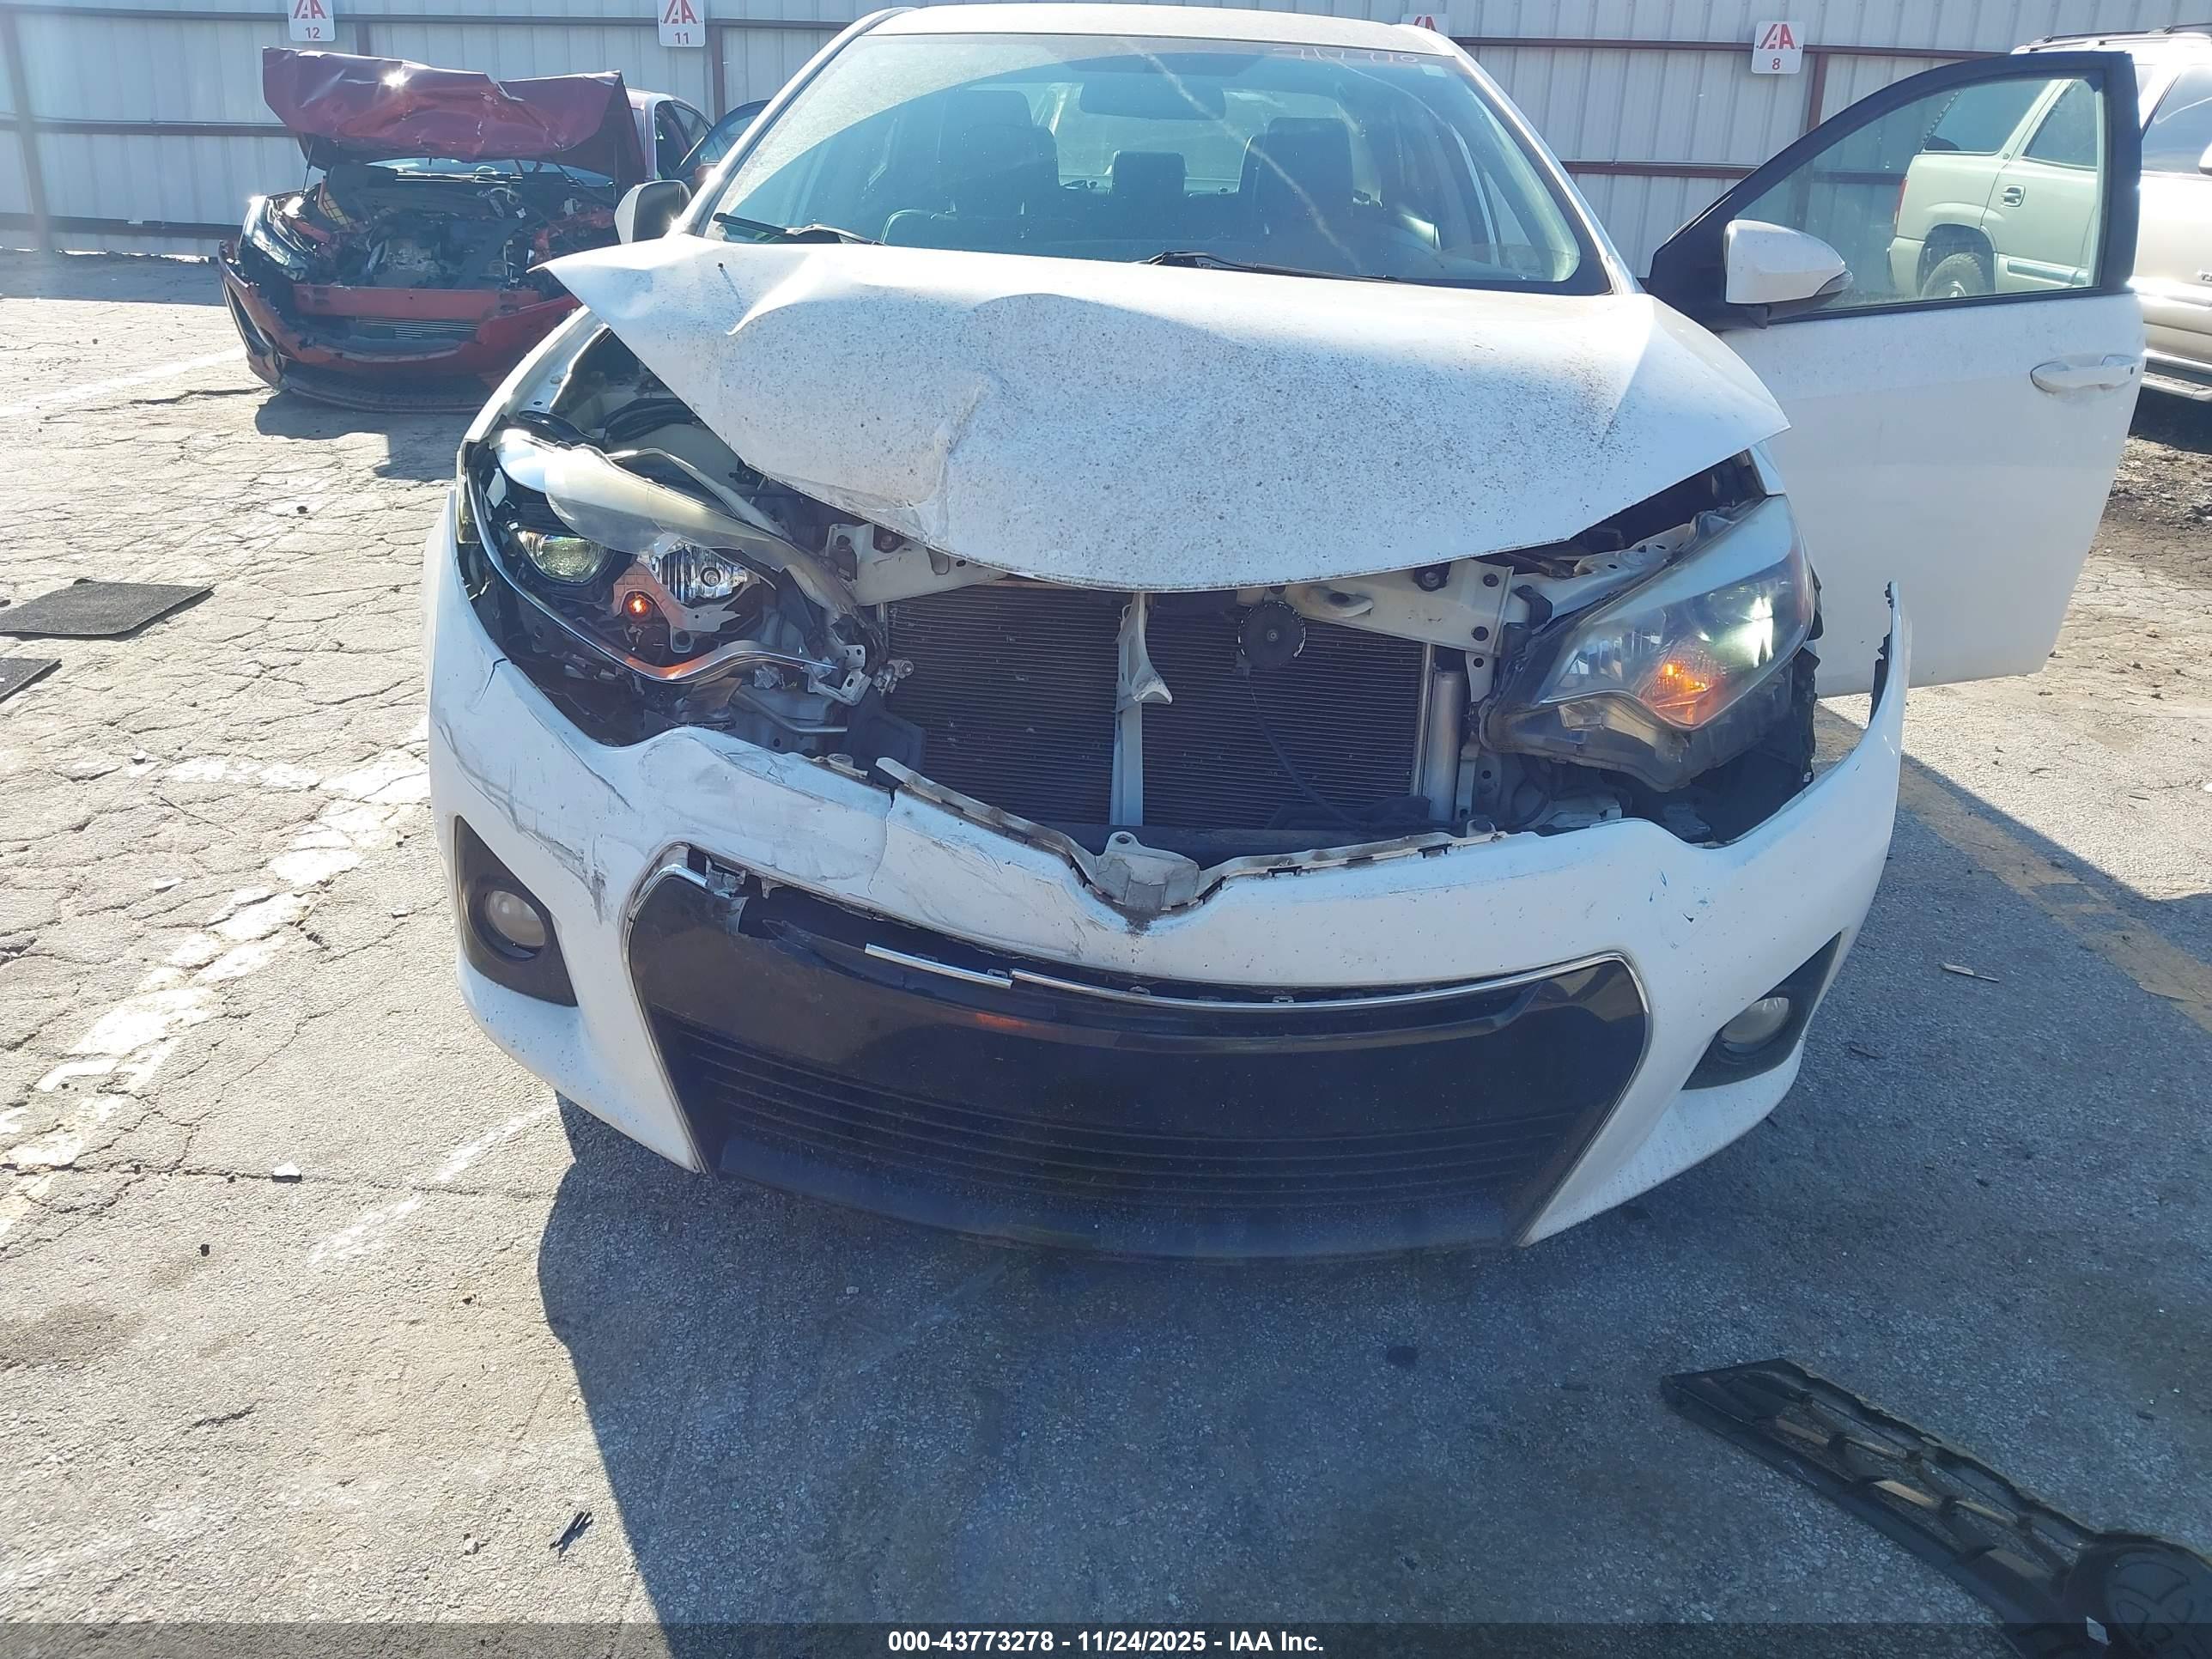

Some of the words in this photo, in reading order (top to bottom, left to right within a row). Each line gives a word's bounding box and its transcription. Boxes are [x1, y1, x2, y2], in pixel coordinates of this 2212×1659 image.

[305, 27, 321, 40] 12
[674, 32, 690, 45] 11
[1771, 58, 1782, 70] 8
